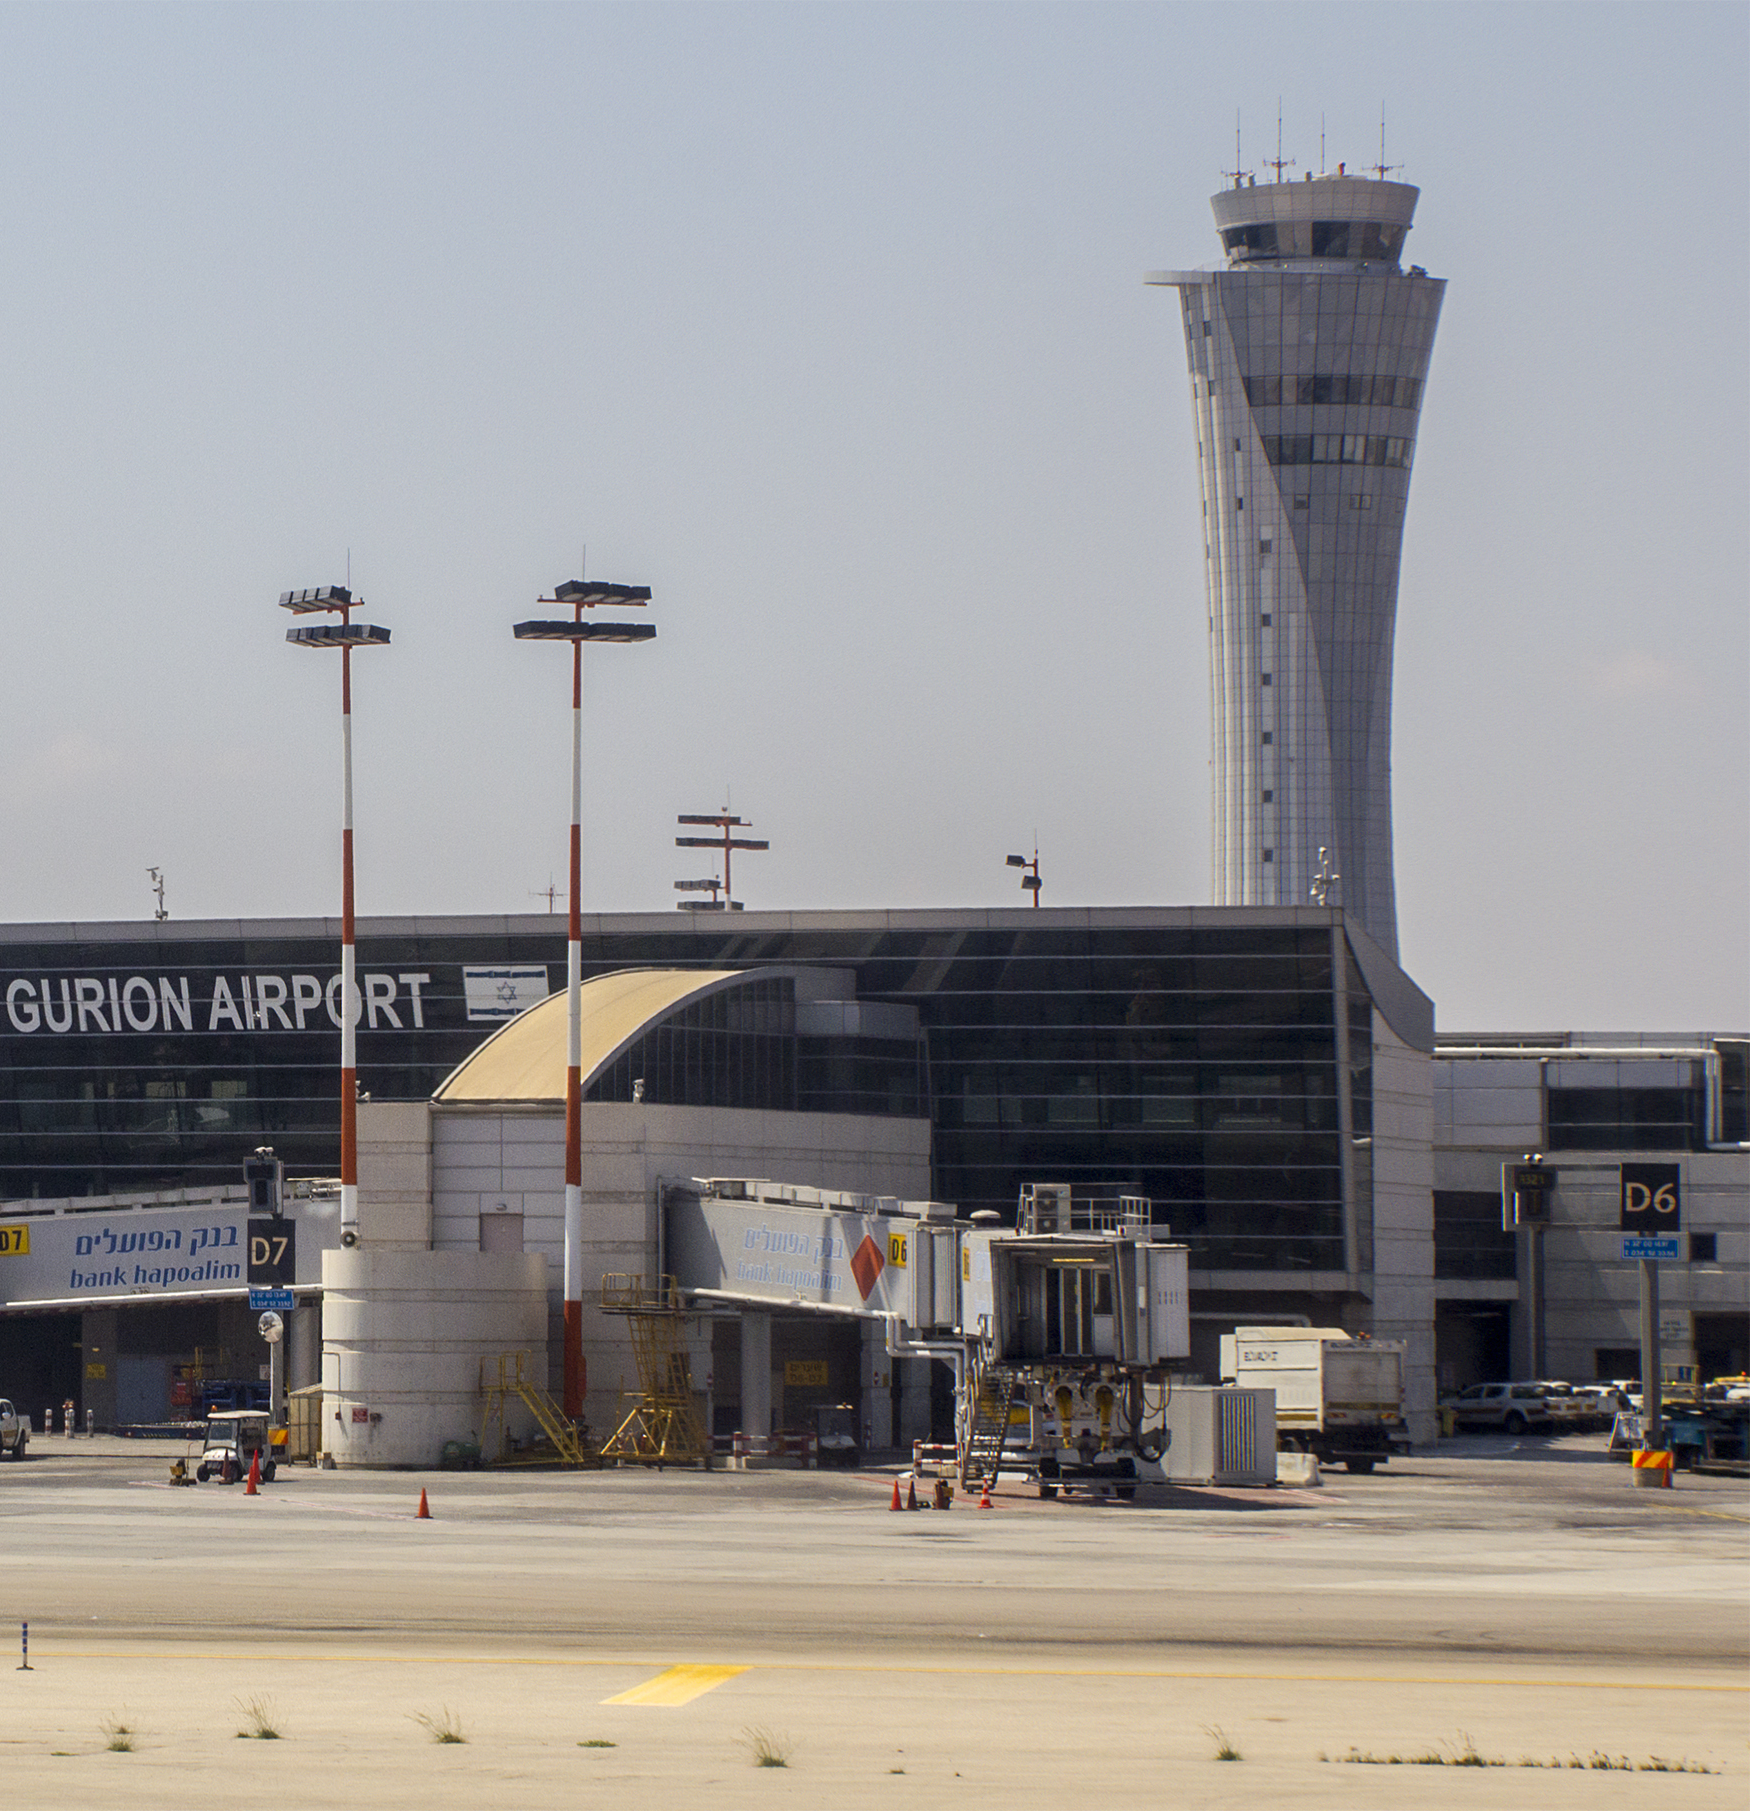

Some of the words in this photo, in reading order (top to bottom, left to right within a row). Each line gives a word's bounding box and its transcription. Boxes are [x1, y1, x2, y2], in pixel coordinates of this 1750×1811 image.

[6, 976, 193, 1033] GURION
[208, 973, 431, 1031] AIRPORT
[1625, 1182, 1677, 1213] D6
[75, 1228, 182, 1256] הפועלים
[189, 1225, 239, 1256] בנק
[251, 1236, 289, 1266] D7
[744, 1223, 810, 1256] הפועלים
[814, 1235, 844, 1265] בנק
[892, 1238, 907, 1262] D6
[70, 1266, 127, 1289] bank
[133, 1260, 241, 1288] hapoalim
[737, 1261, 772, 1283] bank
[776, 1264, 842, 1291] hapoalim
